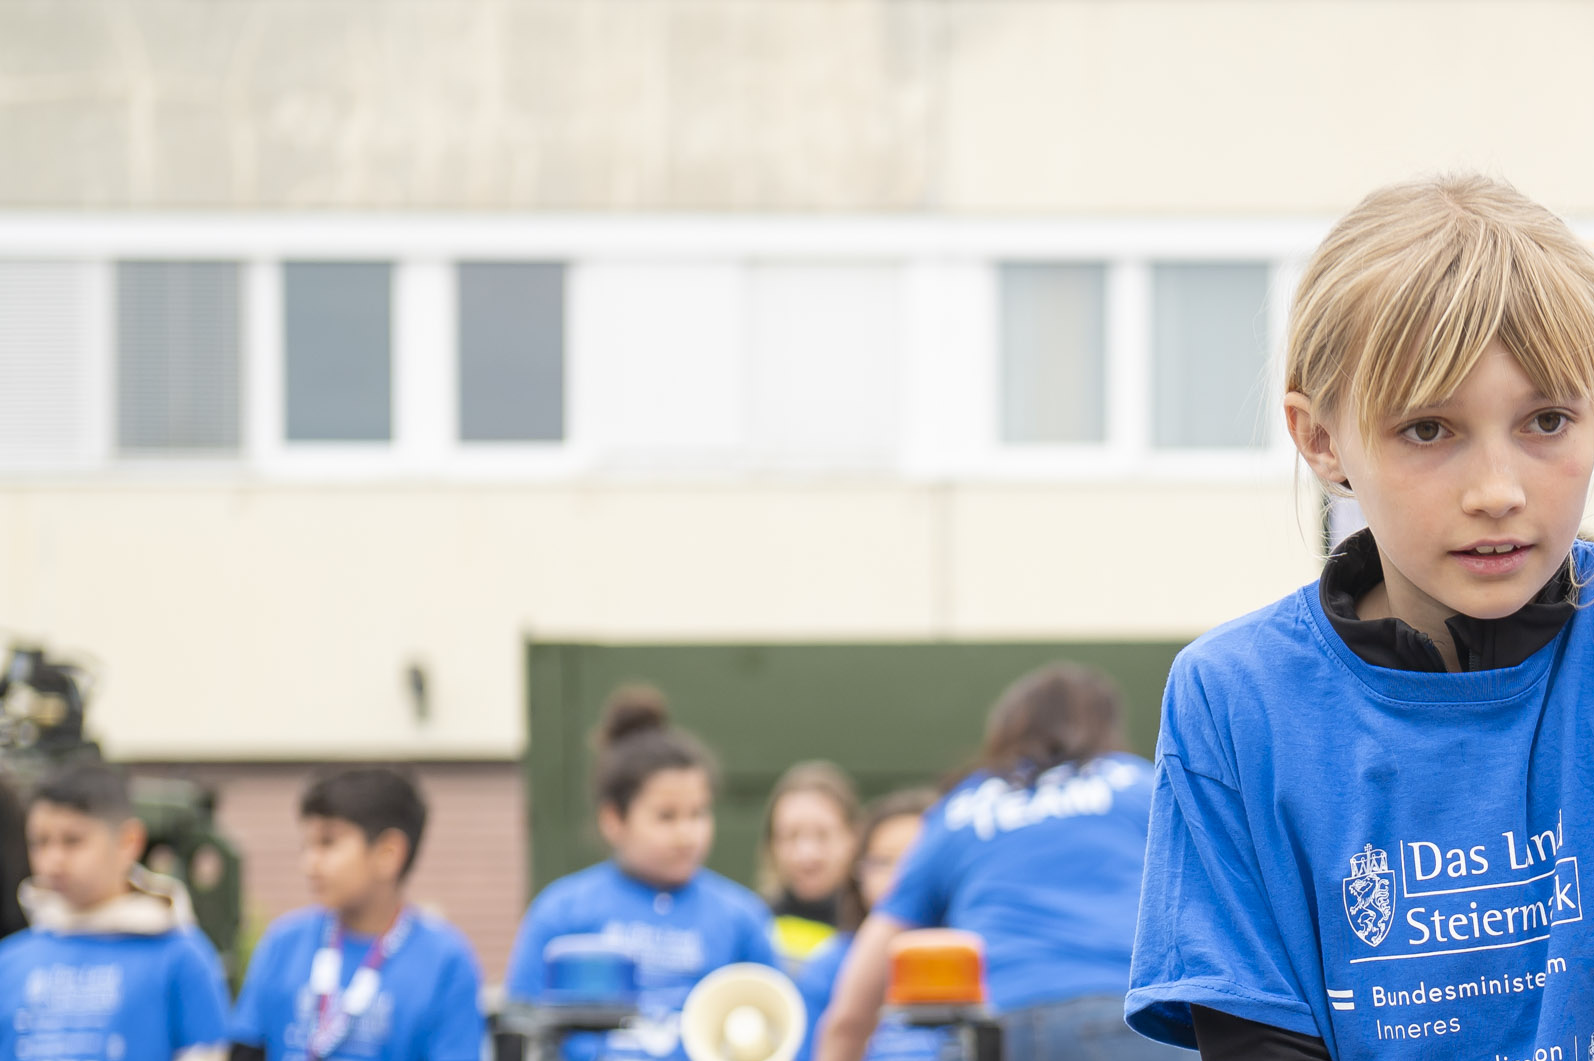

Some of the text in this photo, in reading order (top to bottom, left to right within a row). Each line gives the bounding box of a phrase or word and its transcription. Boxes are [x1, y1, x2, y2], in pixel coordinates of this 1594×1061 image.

[1408, 841, 1489, 881] Das
[1406, 874, 1576, 945] Steiermk
[1373, 957, 1566, 1008] Bundesministem
[1376, 1016, 1461, 1041] Inneres
